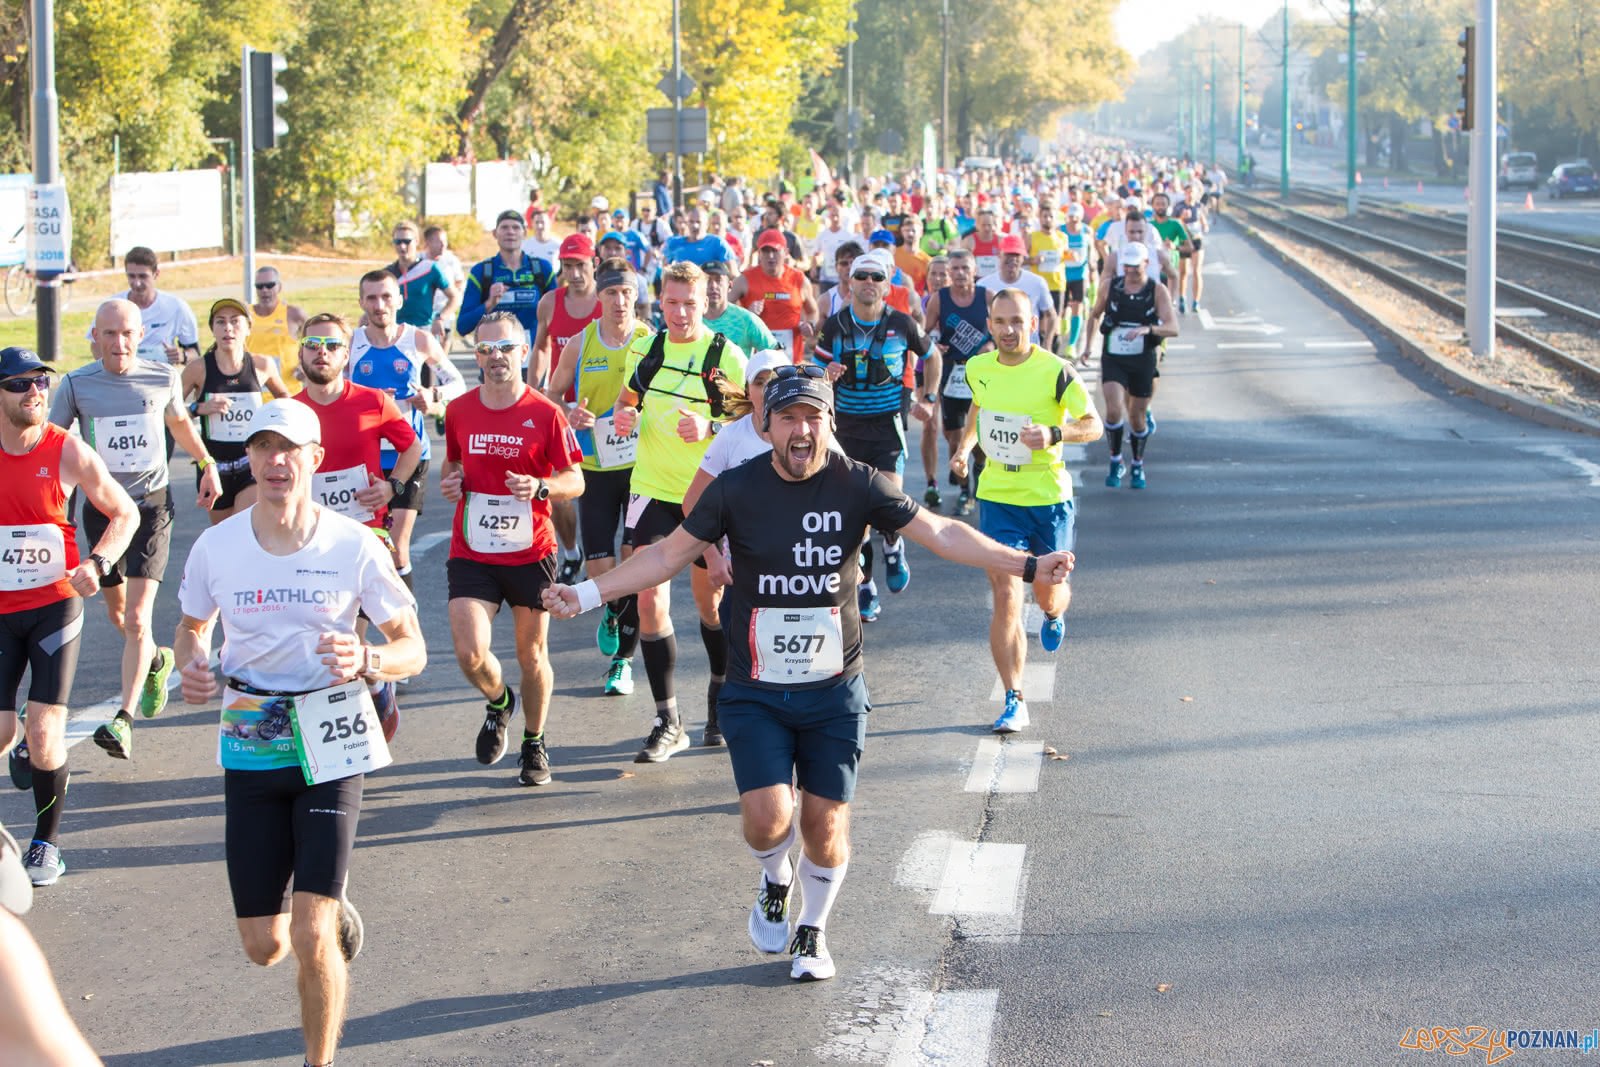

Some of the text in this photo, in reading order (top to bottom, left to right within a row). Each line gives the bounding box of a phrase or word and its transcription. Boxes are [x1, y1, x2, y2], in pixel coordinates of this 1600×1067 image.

[220, 409, 253, 422] 1060
[108, 434, 148, 450] 4814
[480, 433, 524, 446] NETBOX
[989, 428, 1019, 445] 4119
[488, 443, 520, 459] biega
[479, 514, 520, 530] 4257
[802, 510, 842, 533] on
[2, 547, 51, 565] 4730
[792, 537, 842, 567] the
[758, 571, 841, 596] move
[232, 607, 241, 615] 17
[242, 607, 259, 615] lipca
[773, 634, 826, 653] 5677
[319, 712, 376, 744] 256
[277, 743, 291, 752] 40
[343, 739, 369, 751] Fabian
